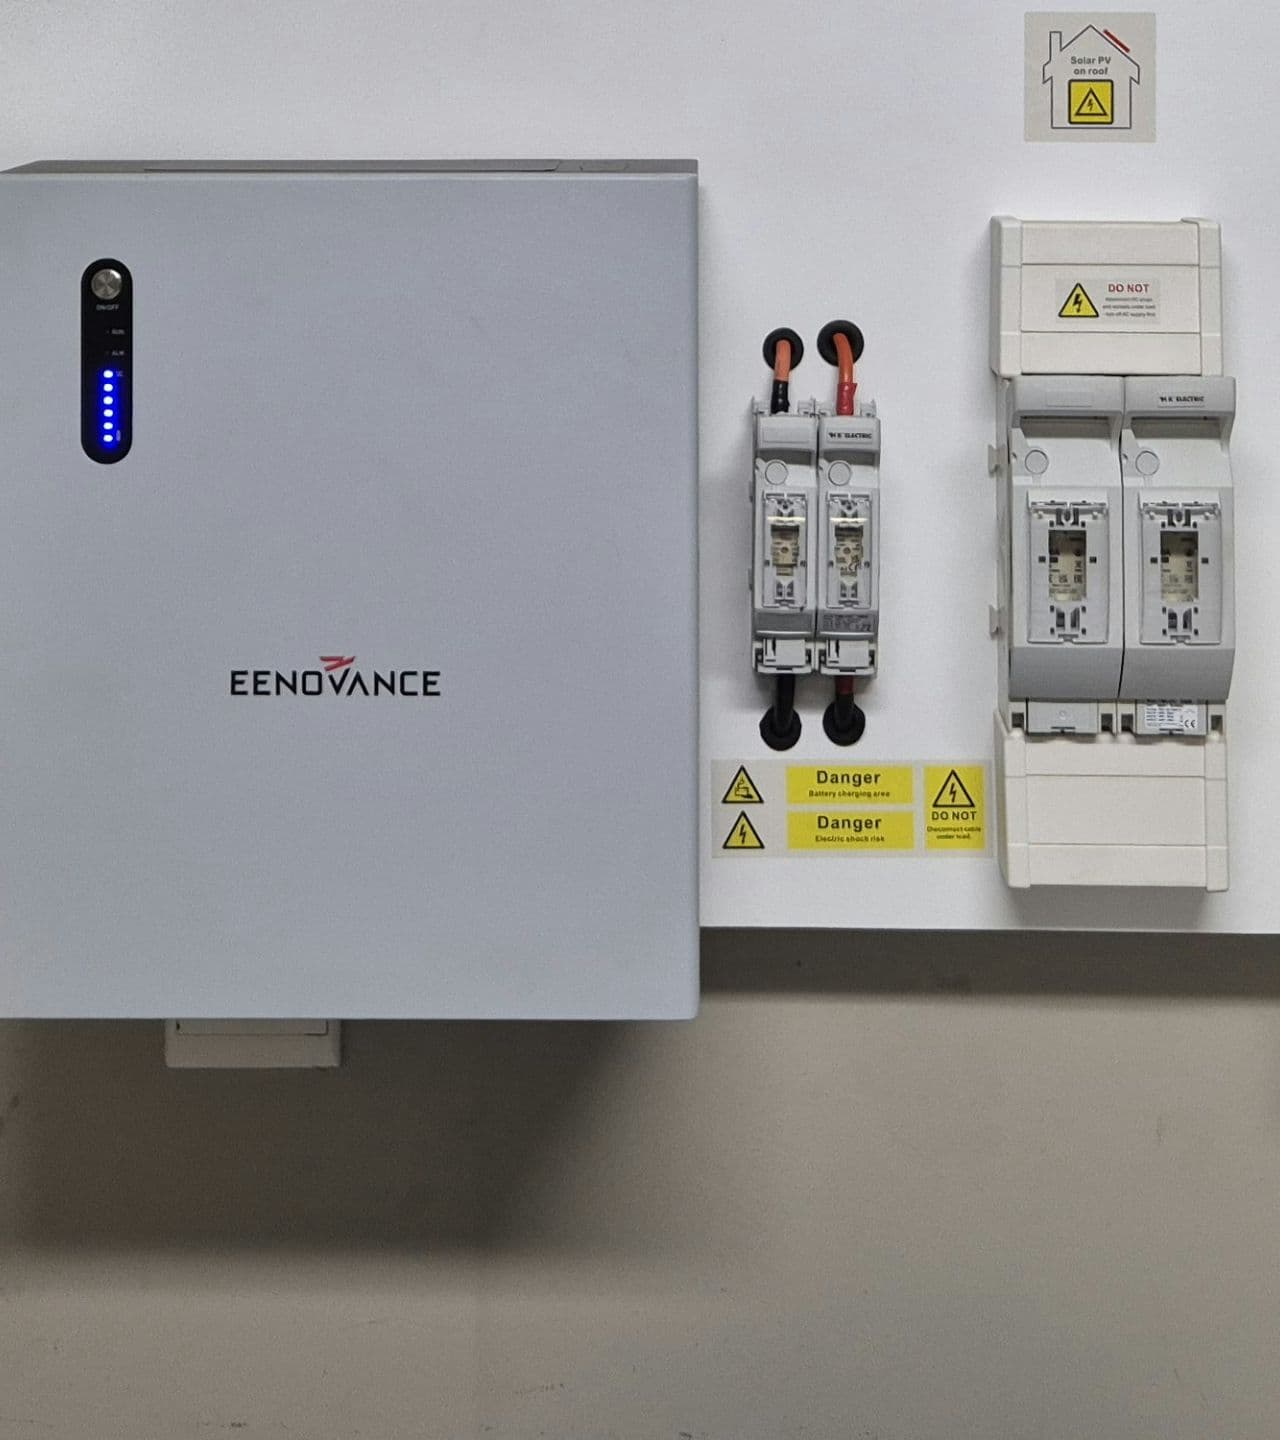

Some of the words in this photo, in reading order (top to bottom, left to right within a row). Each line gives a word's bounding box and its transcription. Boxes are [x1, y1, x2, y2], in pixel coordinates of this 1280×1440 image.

[1070, 56, 1096, 65] Solar
[1098, 56, 1112, 65] PV
[1088, 67, 1109, 75] roof
[1107, 283, 1125, 293] DO
[1127, 283, 1150, 293] NOT
[230, 666, 441, 696] EENOVANCE
[816, 769, 881, 788] Danger
[808, 790, 837, 799] Battery
[837, 790, 872, 799] charging
[931, 811, 949, 821] DO
[952, 811, 977, 821] NOT
[816, 815, 882, 832] Danger
[815, 835, 845, 843] Electric
[845, 835, 869, 843] shock
[870, 835, 886, 843] risk
